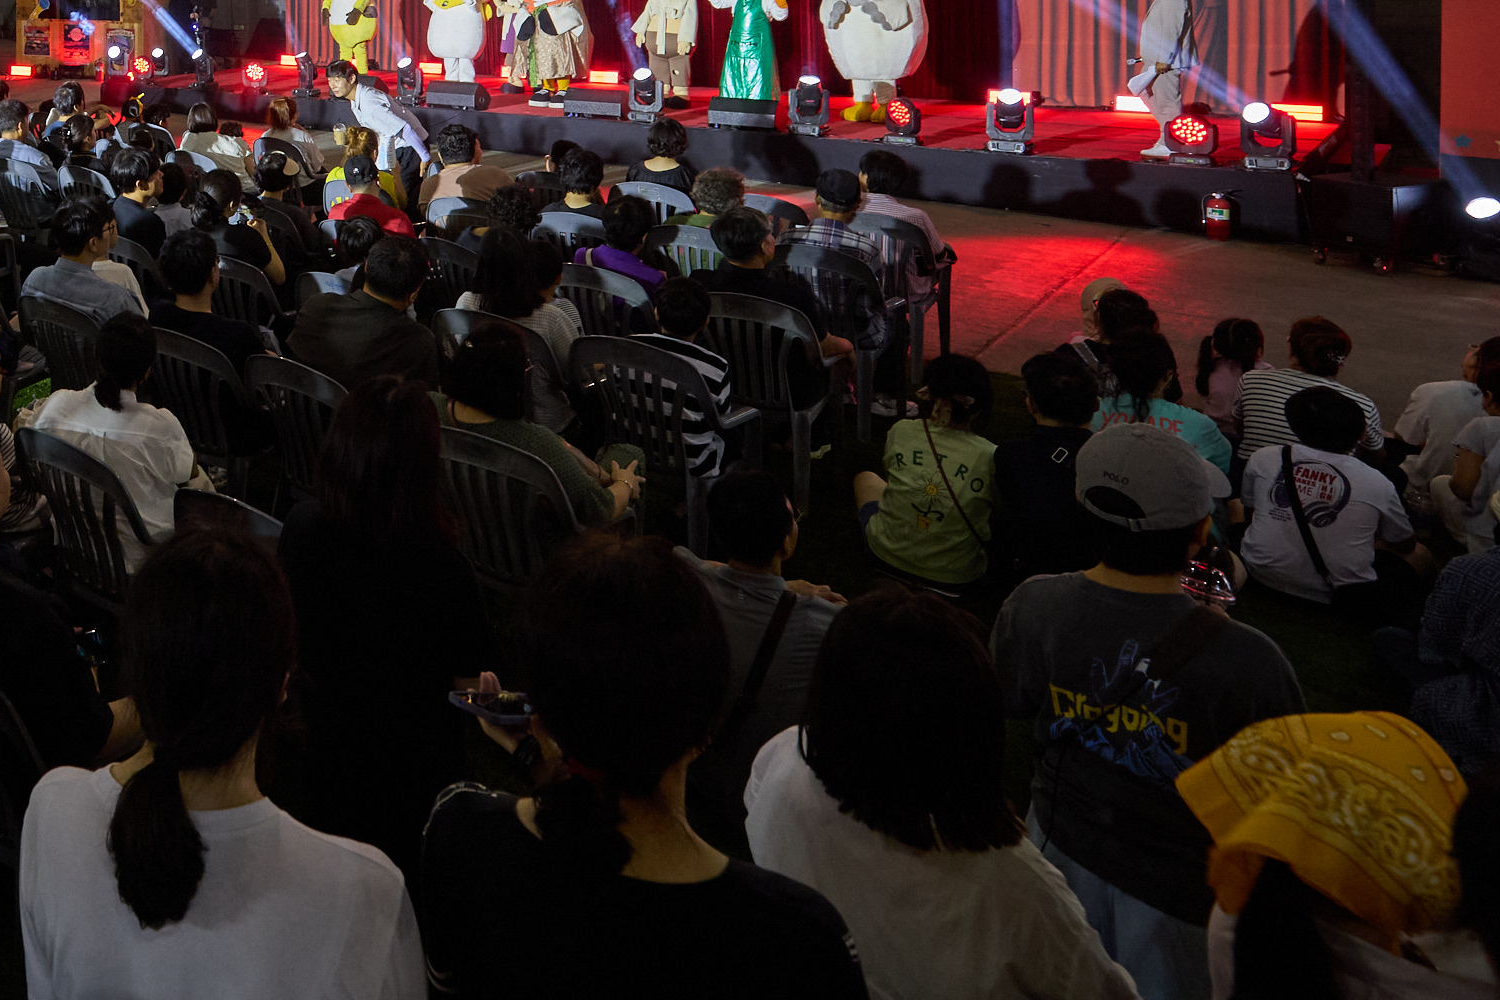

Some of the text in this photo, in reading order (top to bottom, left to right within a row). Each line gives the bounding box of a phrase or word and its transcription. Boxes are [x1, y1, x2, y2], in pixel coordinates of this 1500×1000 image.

[895, 450, 984, 493] RETRO
[1103, 471, 1129, 485] POLO
[1295, 466, 1337, 485] FANKY
[1297, 484, 1314, 497] ME
